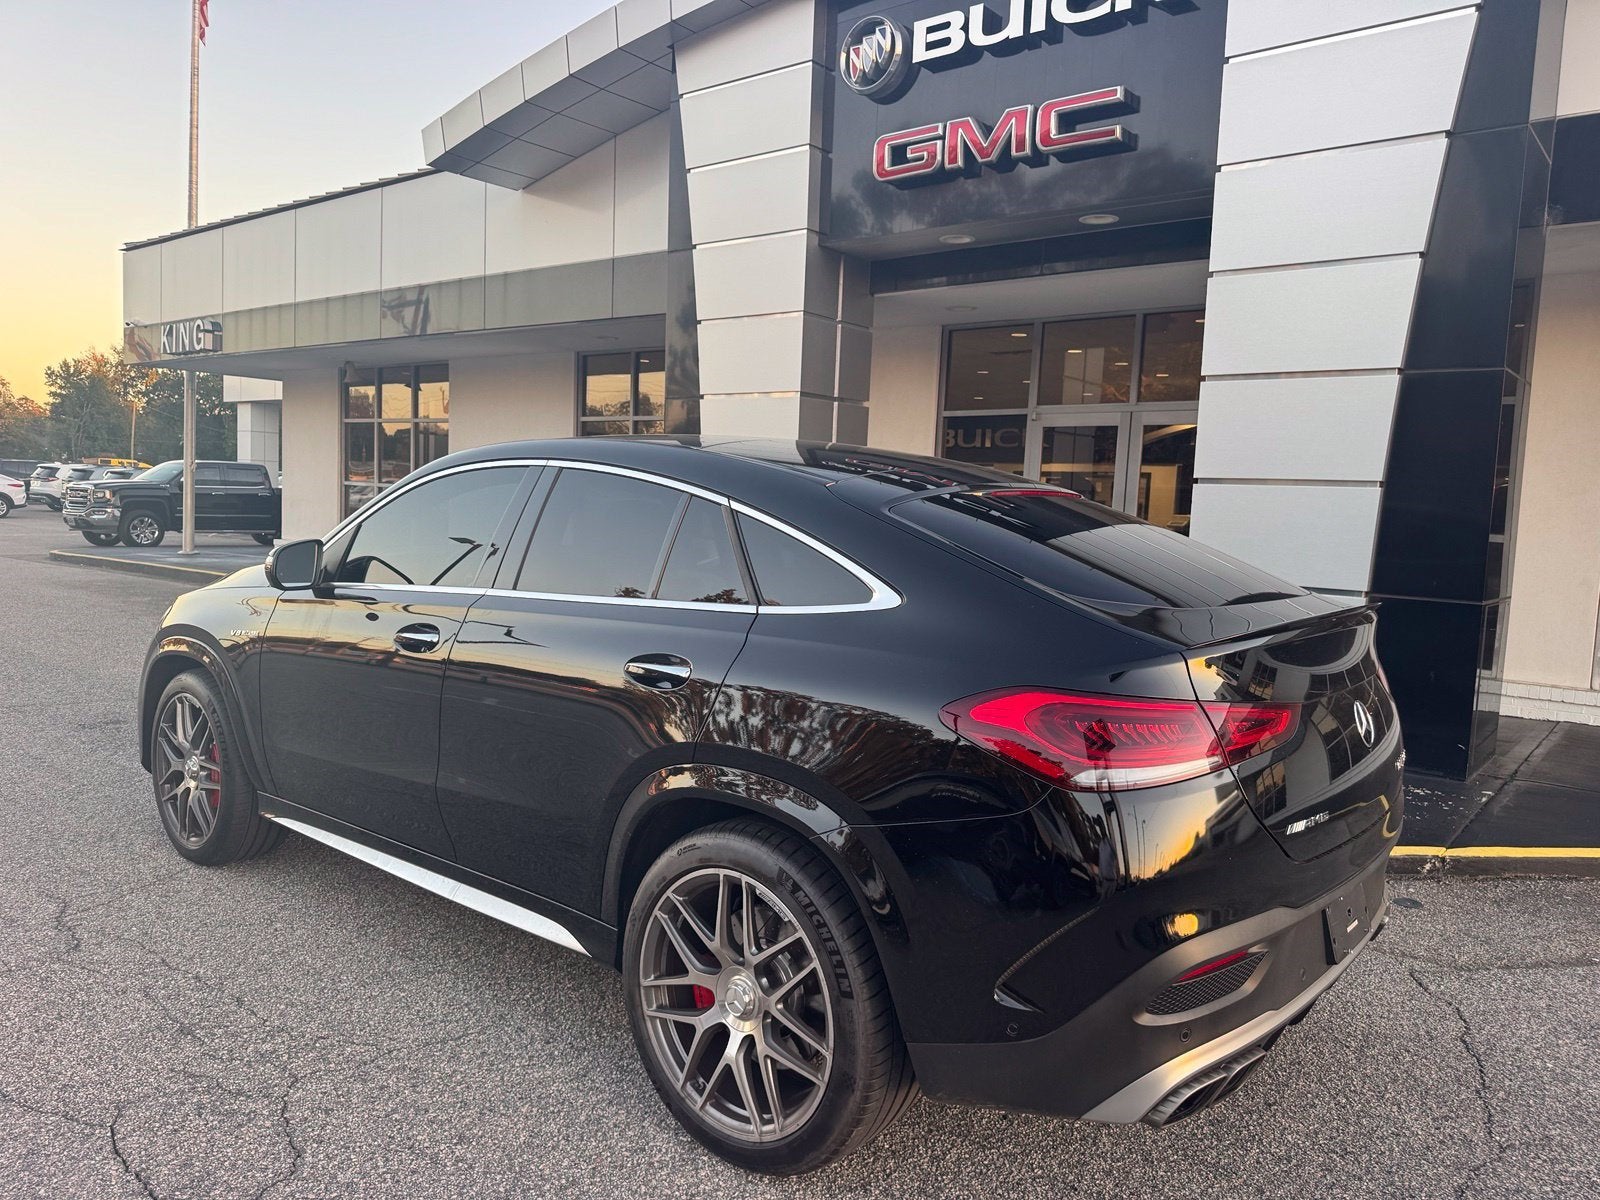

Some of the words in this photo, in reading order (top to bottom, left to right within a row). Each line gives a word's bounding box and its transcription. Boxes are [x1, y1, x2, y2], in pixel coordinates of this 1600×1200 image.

[912, 0, 1160, 63] BUI
[873, 85, 1124, 183] GMC
[160, 319, 204, 354] KING
[795, 890, 853, 995] MICHELIN
